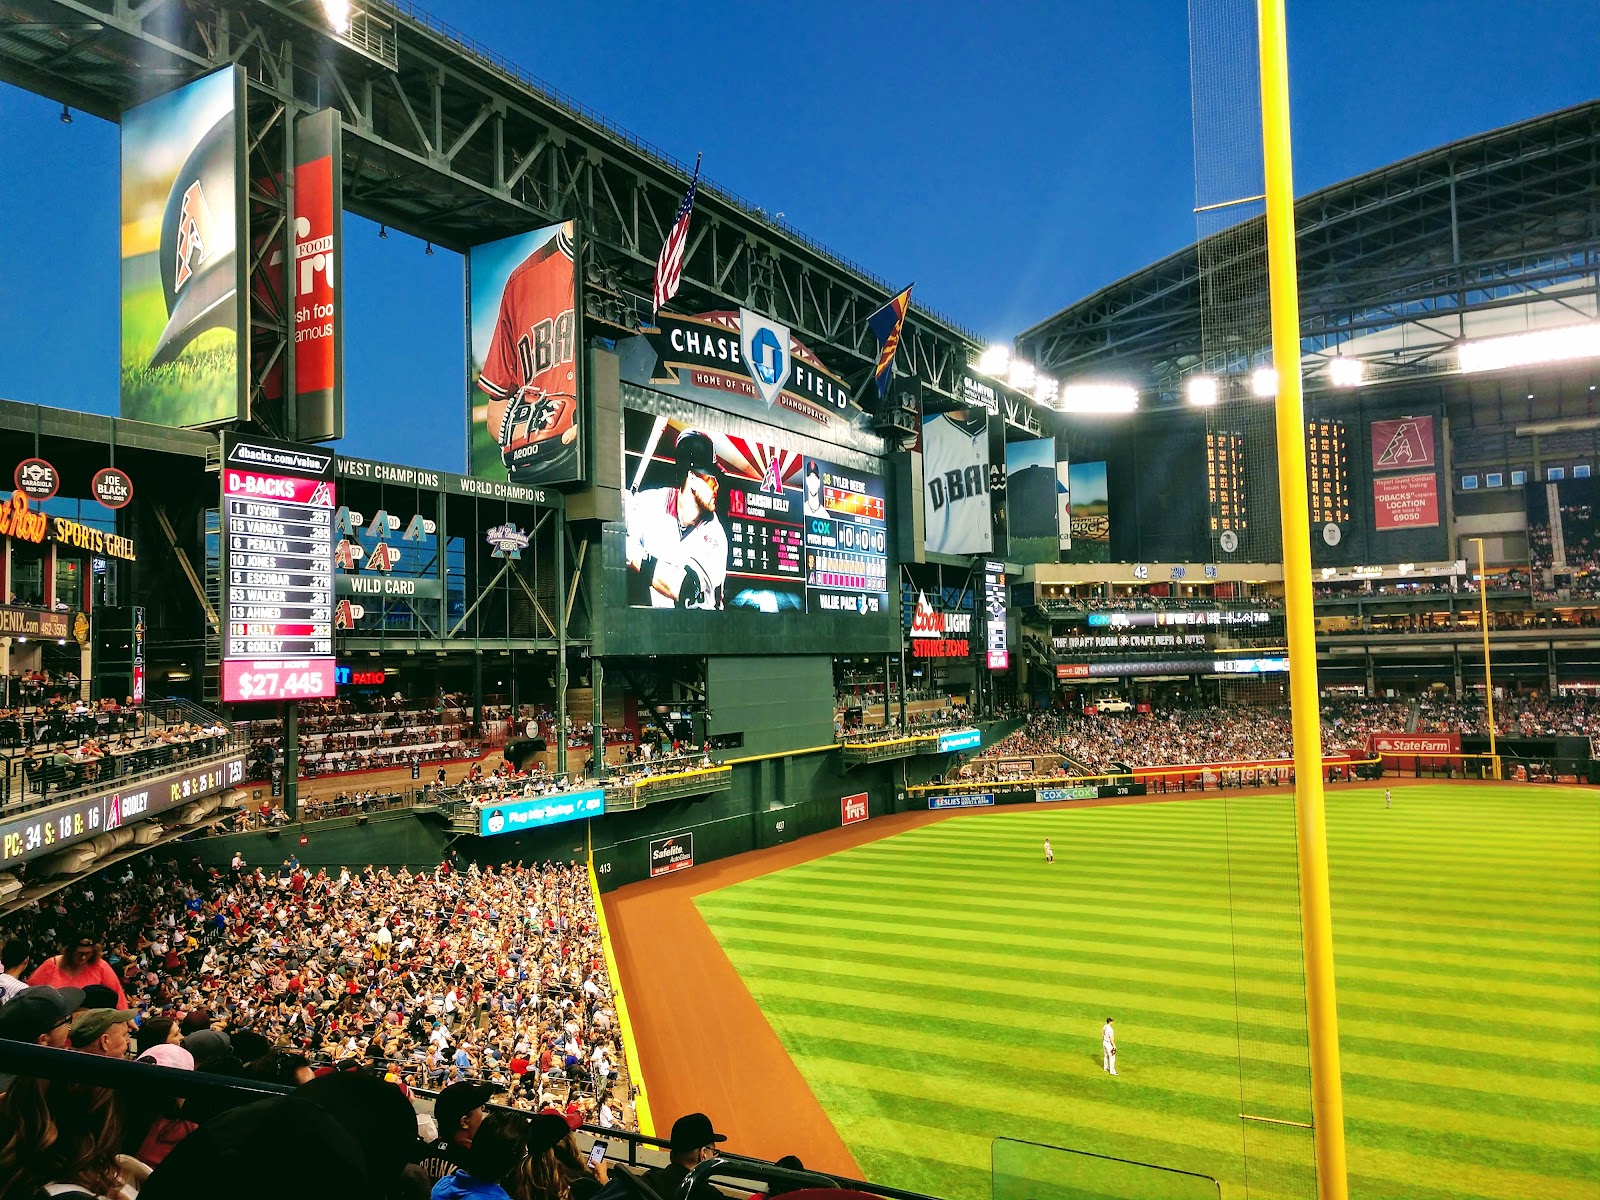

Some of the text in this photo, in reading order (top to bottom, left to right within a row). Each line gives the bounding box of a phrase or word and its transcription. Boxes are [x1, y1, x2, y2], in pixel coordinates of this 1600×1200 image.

[298, 238, 331, 256] FOOD
[670, 328, 847, 409] CHASE FIELD
[696, 374, 756, 395] HOME OF THE
[781, 396, 829, 424] DIAMONDBACKS
[514, 444, 539, 461] A2000
[338, 459, 439, 487] WEST CHAMPIONS
[22, 480, 52, 489] GARAGIOLA
[104, 476, 120, 486] JOE
[230, 474, 295, 498] D-BACKS
[832, 475, 849, 489] TYLER
[98, 484, 127, 496] BLACK
[460, 478, 545, 503] WORLD CHAMPIONS
[1375, 492, 1415, 502] "DBACKS"
[730, 490, 745, 514] 18
[1386, 499, 1426, 510] LOCATION
[9, 490, 47, 543] Row
[235, 503, 240, 514] 1
[246, 504, 279, 518] DYSON
[1394, 513, 1420, 522] 69050
[232, 520, 285, 535] 15 VARGAS
[350, 513, 434, 532] 99 01 02
[812, 520, 831, 535] COX
[55, 518, 136, 560] SPORTS GRILL
[234, 538, 288, 552] 6 PERALTA
[501, 542, 517, 550] 2001
[808, 534, 836, 548] PITCH SPEED
[846, 528, 853, 547] 0
[862, 531, 869, 550] 0
[877, 534, 884, 552] 0
[352, 548, 397, 559] 07 11
[232, 555, 244, 566] 10
[246, 556, 276, 568] JONES
[234, 572, 290, 586] 5 ESCOBAR
[1134, 566, 1217, 579] 42 20 51
[351, 578, 415, 595] WILD CARD
[232, 589, 286, 602] 53 WALKER
[820, 595, 840, 609] VALUE
[840, 596, 858, 611] PACK
[232, 606, 281, 619] 13 AHMED
[352, 607, 361, 617] 17
[913, 602, 971, 632] Coors LIGHT
[41, 622, 66, 637] 462-3506
[247, 624, 277, 635] KELLY
[232, 641, 284, 652] 52 GODLEY
[912, 639, 969, 657] STRIKE ZONE
[1052, 638, 1067, 648] THE
[1069, 636, 1094, 648] DRAFT
[1096, 637, 1118, 647] ROOM
[1130, 636, 1154, 646] CRAFT
[239, 672, 323, 699] $27,445
[353, 672, 385, 685] PATIO
[1394, 740, 1447, 751] State Farm
[171, 784, 181, 802] PC:
[182, 780, 191, 798] 36
[192, 779, 198, 794] S:
[200, 776, 207, 792] 25
[216, 770, 222, 786] 11
[1044, 789, 1091, 799] COX COX
[122, 792, 149, 817] GODLEY
[845, 799, 866, 819] fry's
[509, 812, 528, 823] Plug
[545, 804, 574, 817] Savings
[4, 806, 100, 859] PC: 34 S: 18 B: 16
[653, 845, 683, 860] Safelite
[600, 863, 611, 874] 413
